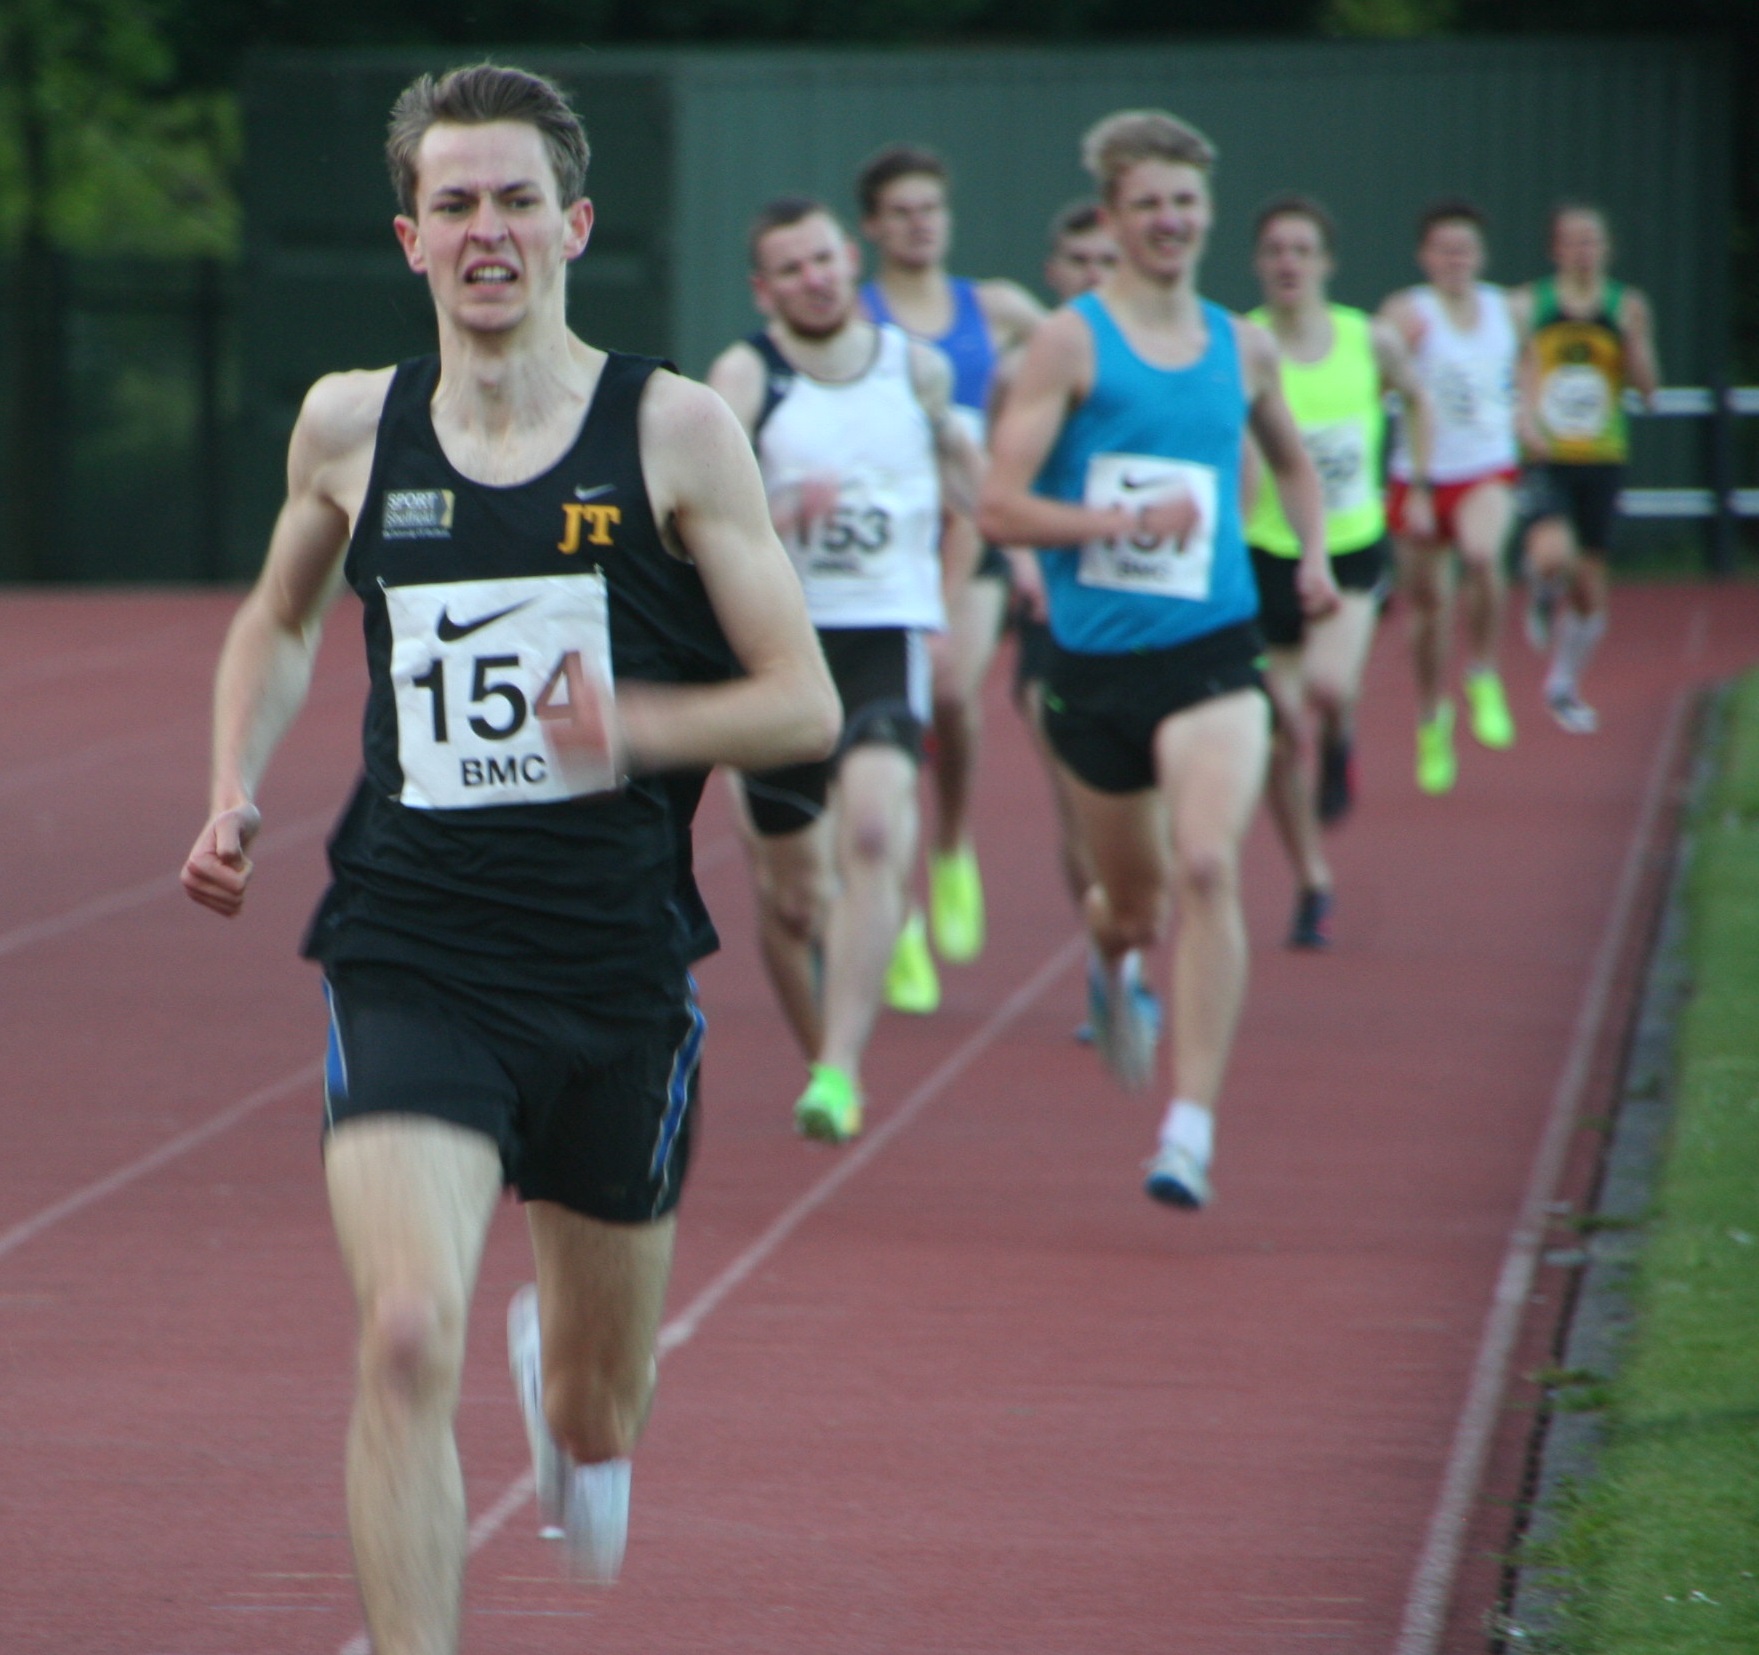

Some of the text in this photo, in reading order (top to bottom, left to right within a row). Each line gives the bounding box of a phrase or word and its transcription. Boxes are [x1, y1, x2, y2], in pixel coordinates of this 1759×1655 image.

[386, 491, 438, 511] SPORT
[557, 503, 621, 555] JT
[412, 650, 588, 744] 154
[460, 753, 547, 787] BMC
